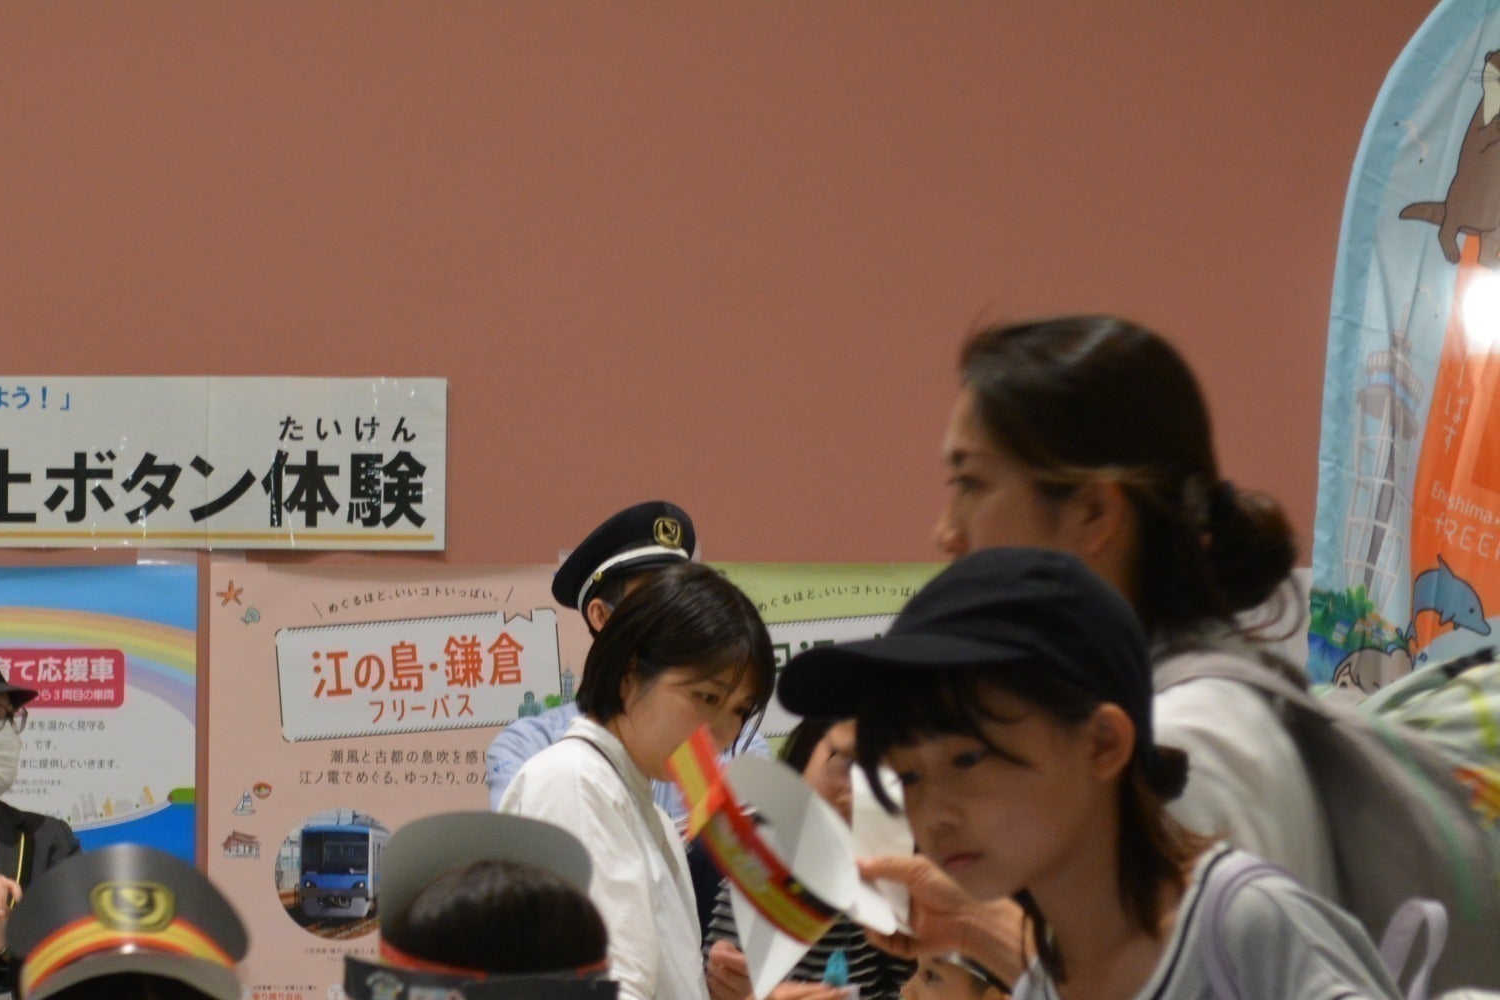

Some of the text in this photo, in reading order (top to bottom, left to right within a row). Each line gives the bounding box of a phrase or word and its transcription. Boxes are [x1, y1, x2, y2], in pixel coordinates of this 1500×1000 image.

[278, 416, 417, 442] たいけん
[312, 632, 524, 698] 江の島・鎌倉
[369, 694, 475, 724] フリーパス
